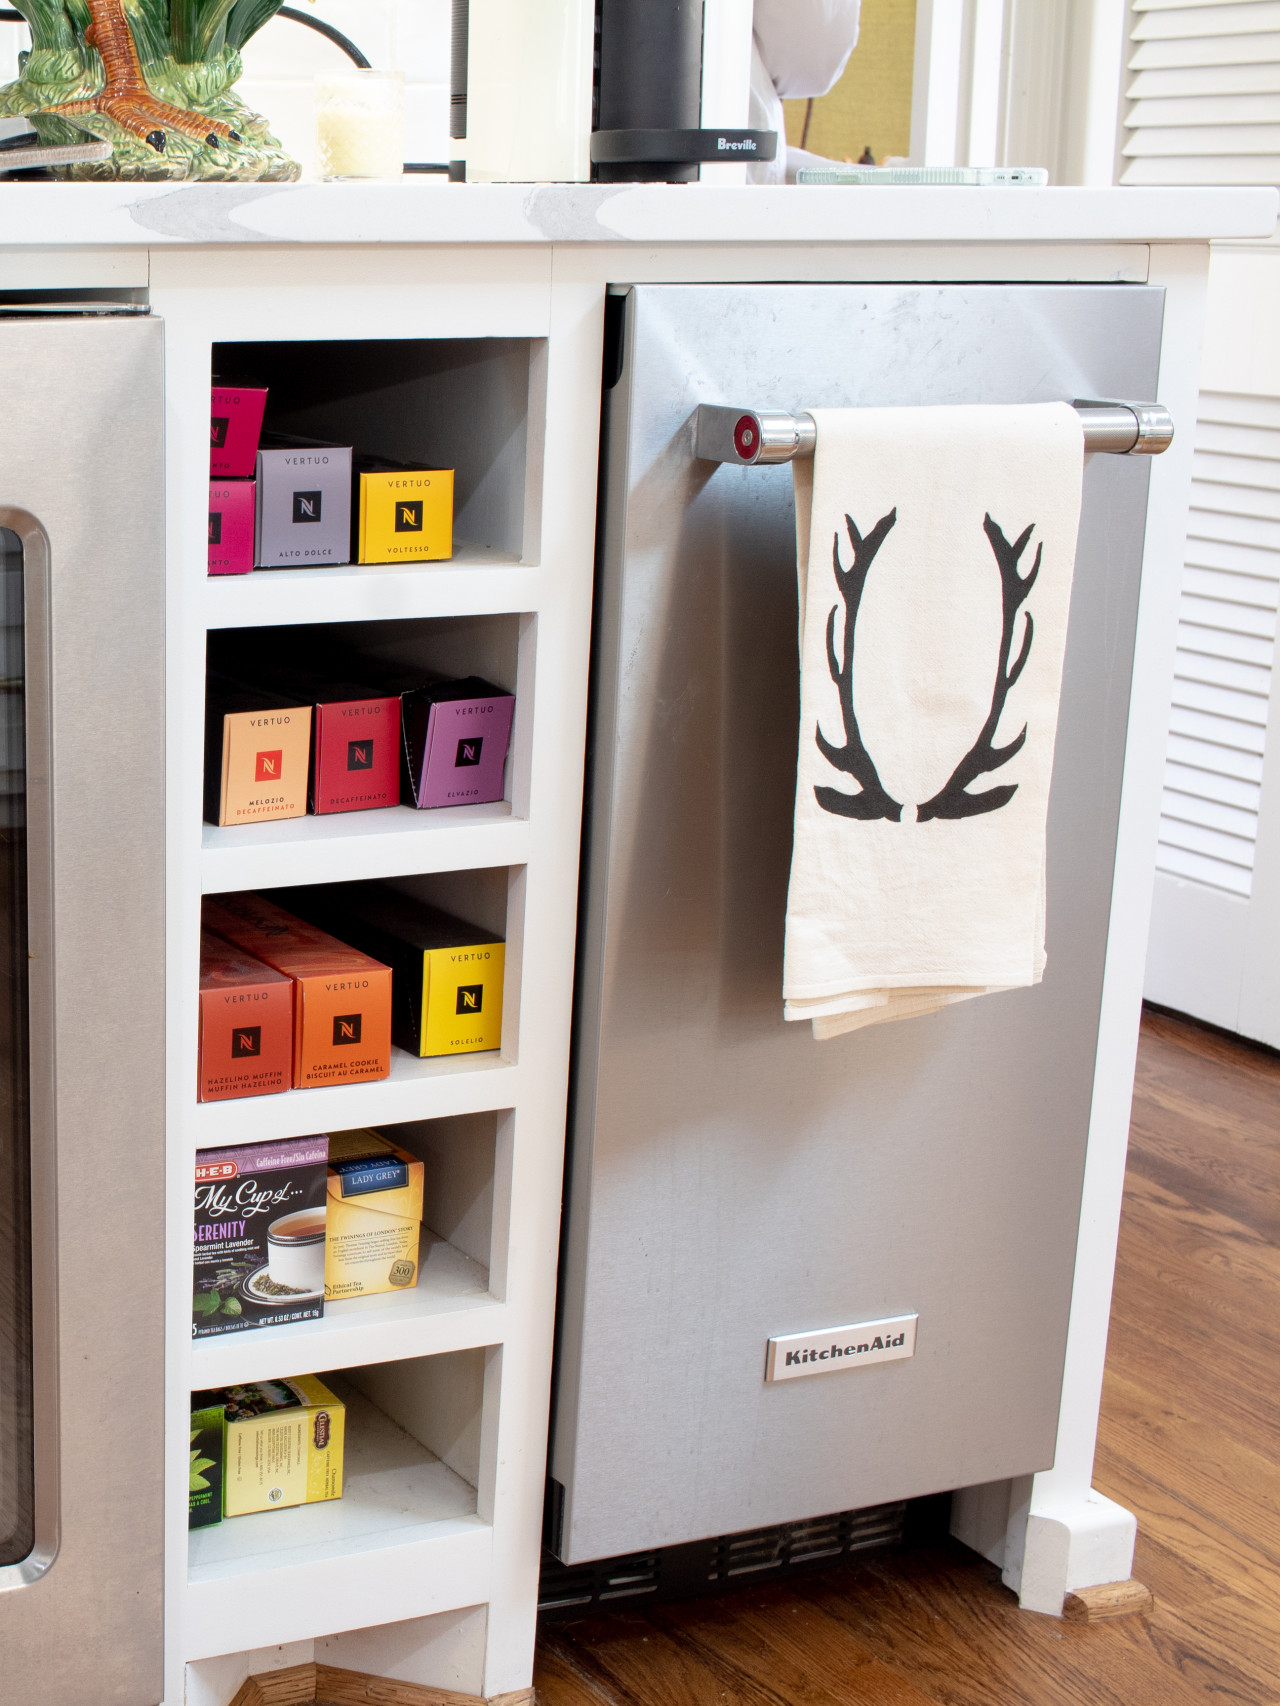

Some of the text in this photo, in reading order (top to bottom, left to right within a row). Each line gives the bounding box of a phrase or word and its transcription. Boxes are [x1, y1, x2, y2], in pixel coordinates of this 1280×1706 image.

[717, 137, 757, 150] Breville
[211, 395, 241, 405] RTUO
[285, 456, 329, 465] VERTUO
[388, 479, 431, 488] VERTUO
[279, 550, 301, 558] ALTO
[387, 546, 429, 554] VOLTESSO
[342, 706, 381, 717] VERTUO
[456, 706, 494, 716] VERTUO
[250, 716, 291, 727] VERTUO
[330, 793, 387, 805] DECAFFEINATO
[448, 790, 479, 798] ELVAZIO
[249, 796, 285, 806] MELOZIO
[236, 803, 295, 816] DECAFFEINATO
[450, 952, 491, 962] VERTUO
[325, 981, 369, 991] VERTUO
[224, 992, 269, 1003] VERTUO
[450, 1037, 483, 1046] SOLELIO
[312, 1059, 378, 1071] CARAMEL COOKIE
[208, 1071, 282, 1085] HAZELINO MUFFIN
[306, 1071, 335, 1080] BISCUIT
[349, 1066, 384, 1075] CARAMEL
[208, 1079, 282, 1093] MUFFIN HAZELINO
[256, 1156, 280, 1167] Caffeine
[351, 1174, 374, 1185] LADY
[194, 1184, 238, 1217] My
[235, 1180, 270, 1217] Cup
[225, 1238, 254, 1249] Lavender
[394, 1266, 410, 1276] 300
[332, 1286, 364, 1295] Partnership
[785, 1332, 905, 1367] KitchenAid
[318, 1414, 326, 1447] CELESTIAL
